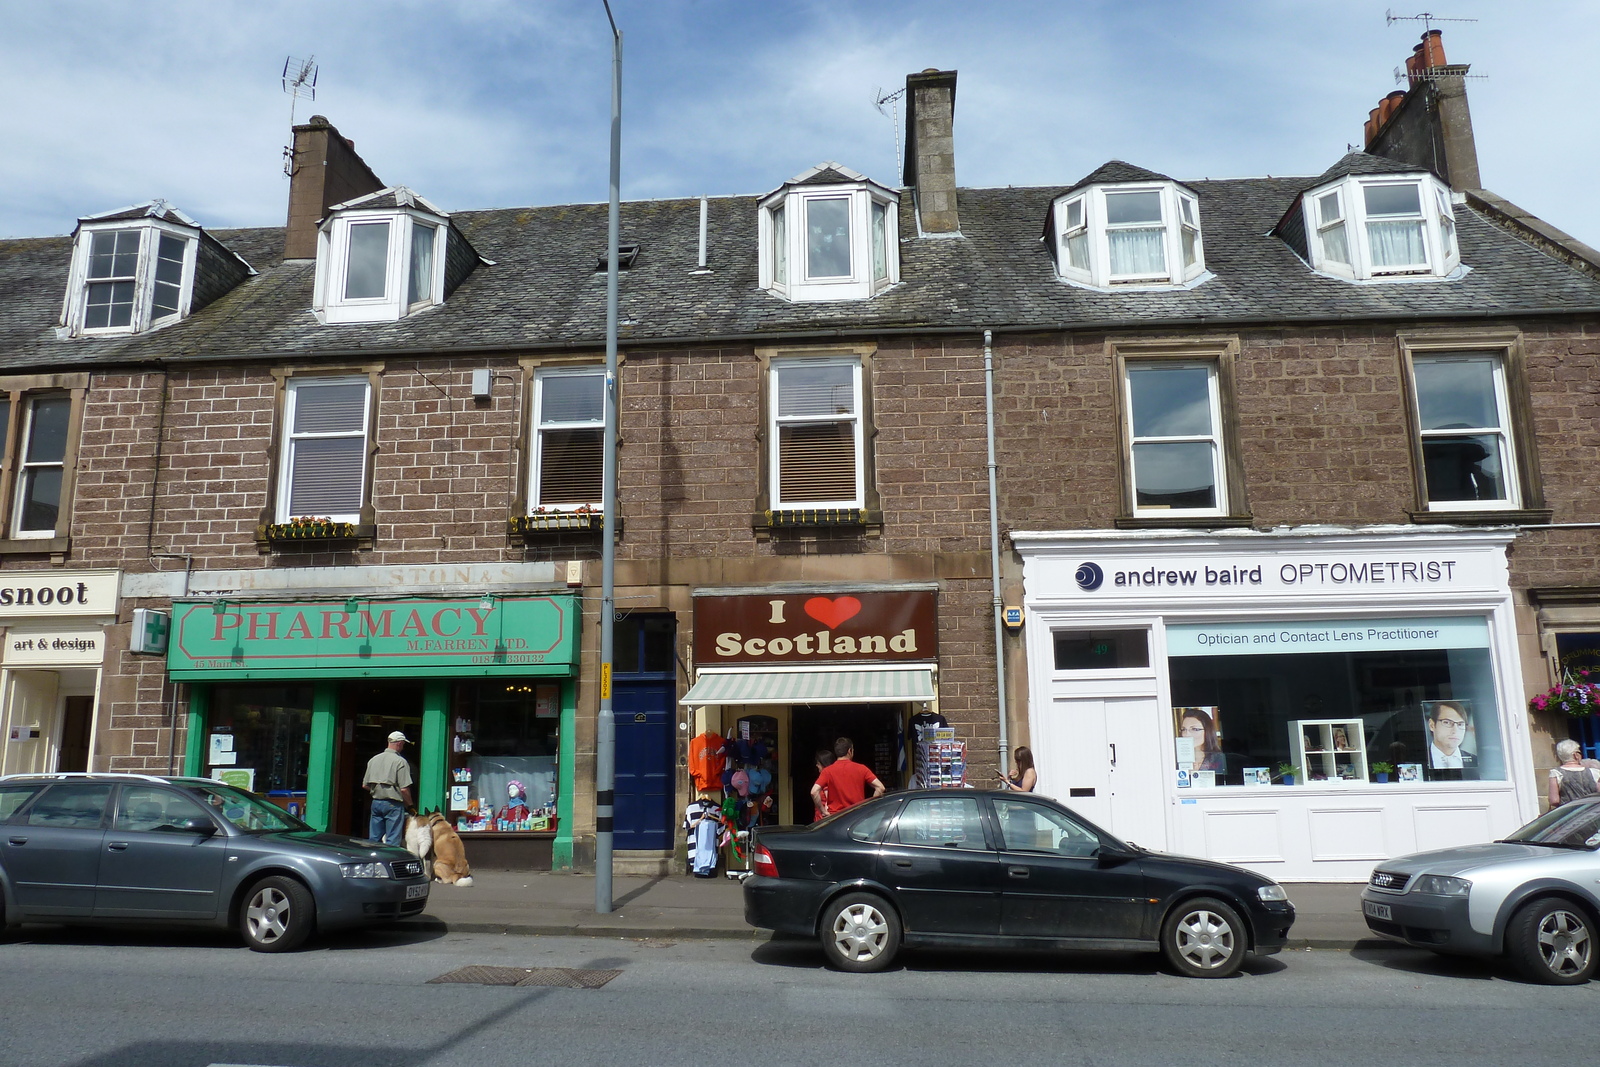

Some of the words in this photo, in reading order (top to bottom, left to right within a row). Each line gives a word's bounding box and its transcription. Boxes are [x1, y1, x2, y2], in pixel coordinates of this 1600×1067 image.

[1114, 566, 1197, 585] andrew
[1205, 565, 1262, 584] baird
[1280, 561, 1456, 584] OPTOMETRIST
[0, 582, 88, 605] snoot
[768, 600, 786, 624] I
[210, 608, 496, 640] PHARMACY
[14, 639, 34, 651] art
[37, 638, 48, 651] &
[52, 637, 96, 652] design
[715, 628, 918, 656] Scotland
[1197, 633, 1249, 646] Optician
[1253, 633, 1276, 644] and
[1280, 631, 1330, 643] Contact
[1333, 630, 1363, 641] Lens
[1368, 628, 1439, 640] Practitioner
[193, 661, 205, 669] 45
[207, 660, 232, 668] Main
[506, 654, 545, 663] 330132
